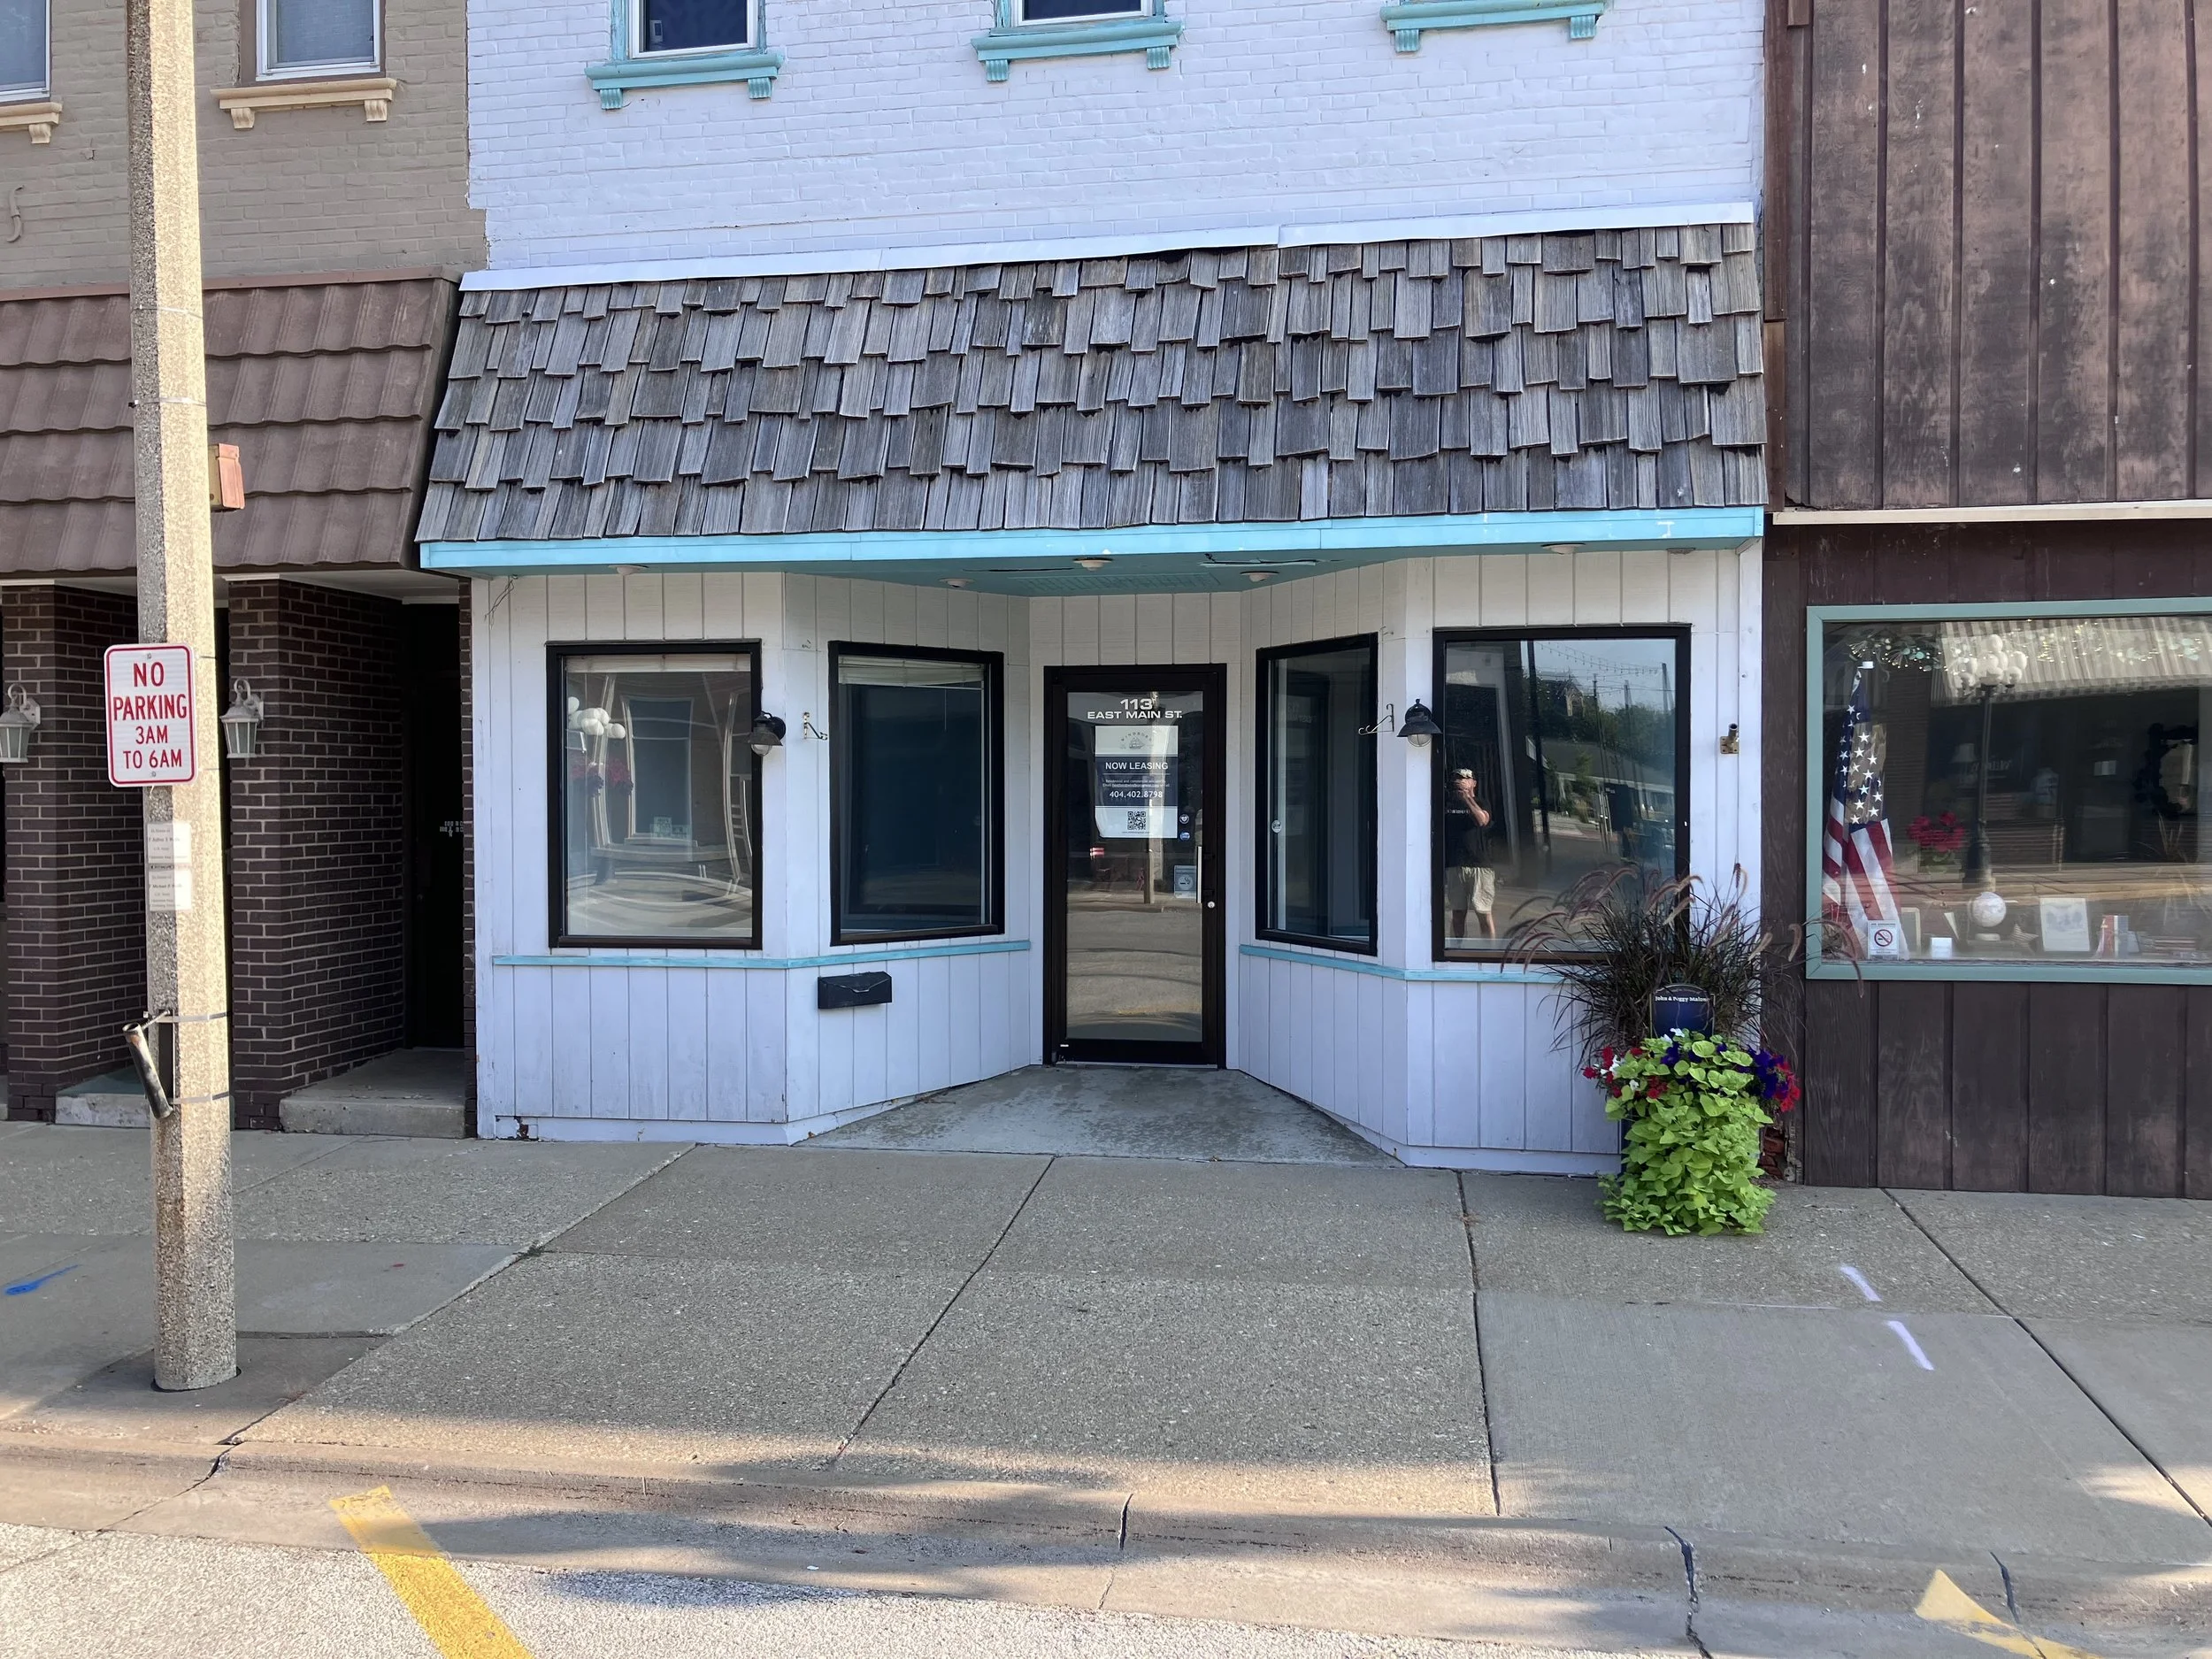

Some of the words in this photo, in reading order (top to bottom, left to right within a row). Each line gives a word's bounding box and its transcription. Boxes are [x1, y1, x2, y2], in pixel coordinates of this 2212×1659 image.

[134, 662, 164, 687] NO
[113, 694, 187, 720] PARKING
[1120, 698, 1153, 710] 113
[1087, 710, 1122, 719] EAST
[1125, 710, 1161, 719] MAIN
[135, 726, 168, 744] 3AM
[123, 750, 142, 769] TO
[149, 749, 182, 768] 6AM
